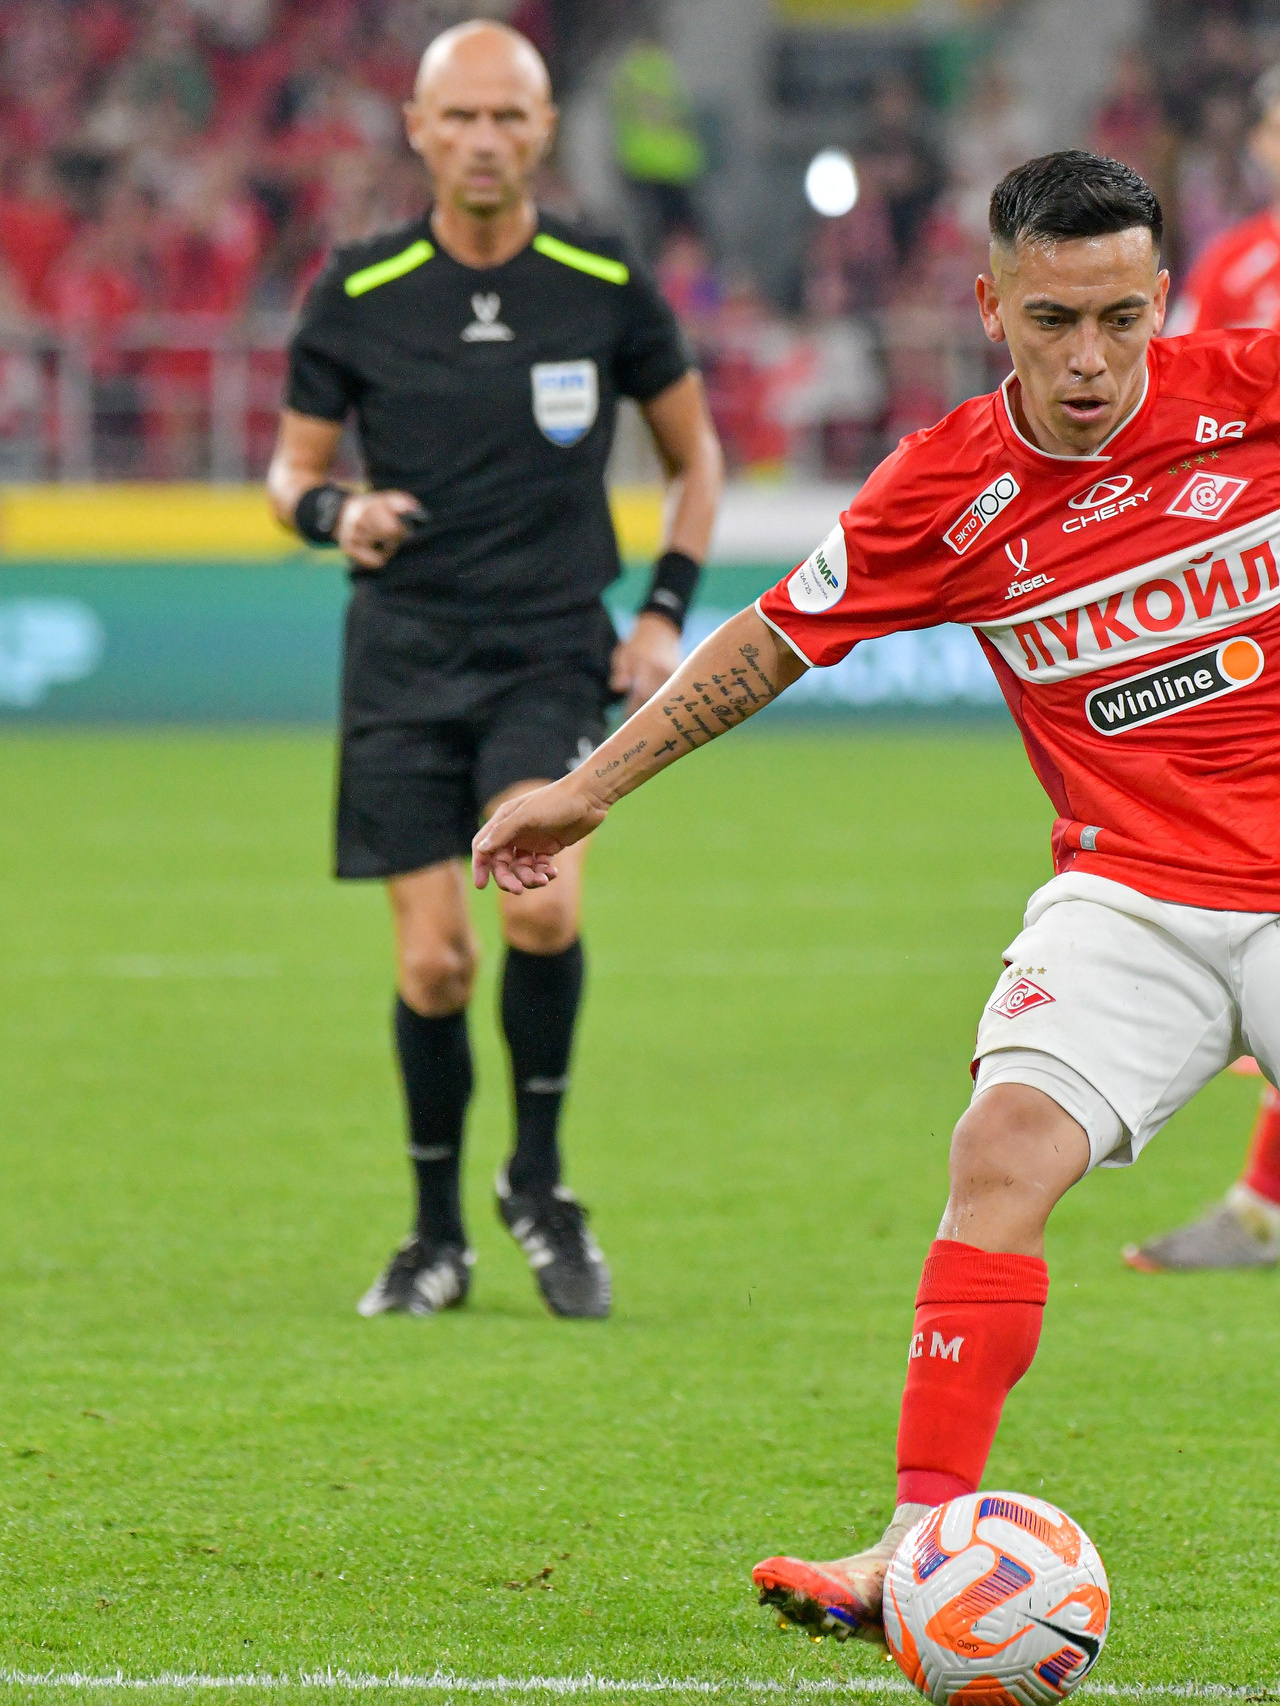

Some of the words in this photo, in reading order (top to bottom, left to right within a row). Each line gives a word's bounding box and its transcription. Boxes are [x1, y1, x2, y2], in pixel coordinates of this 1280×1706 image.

[954, 518, 978, 545] ЭКТО
[972, 478, 1014, 524] 100
[1062, 486, 1153, 534] CHERY
[1004, 573, 1056, 600] JÖGEL
[1012, 540, 1280, 671] ЛУКОЙЛ
[1097, 667, 1214, 724] Winline
[908, 1331, 964, 1364] СМ
